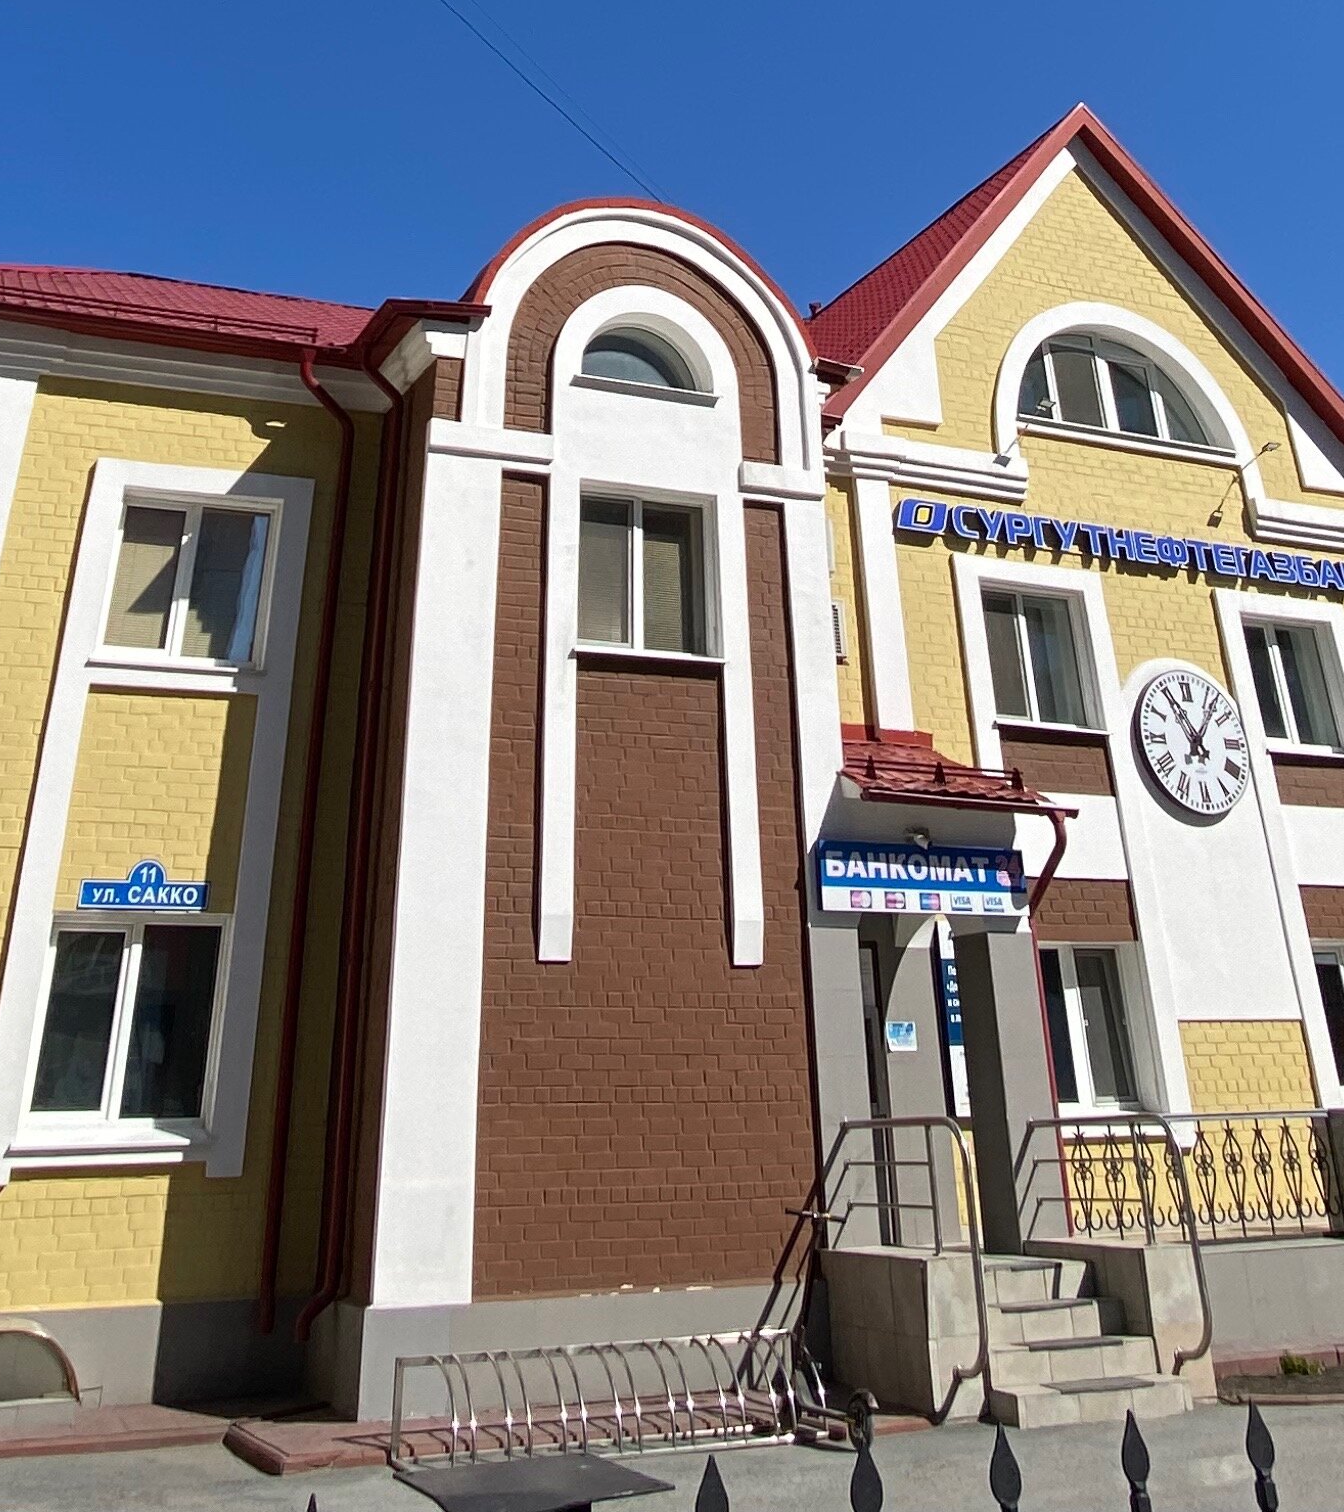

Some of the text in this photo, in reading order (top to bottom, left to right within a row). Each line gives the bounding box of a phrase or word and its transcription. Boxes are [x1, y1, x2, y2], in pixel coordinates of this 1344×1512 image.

[139, 866, 157, 883] 11
[824, 850, 989, 884] БАНКОМАТ
[127, 885, 198, 905] САККО
[953, 896, 971, 907] VISA
[985, 896, 1002, 906] VISA
